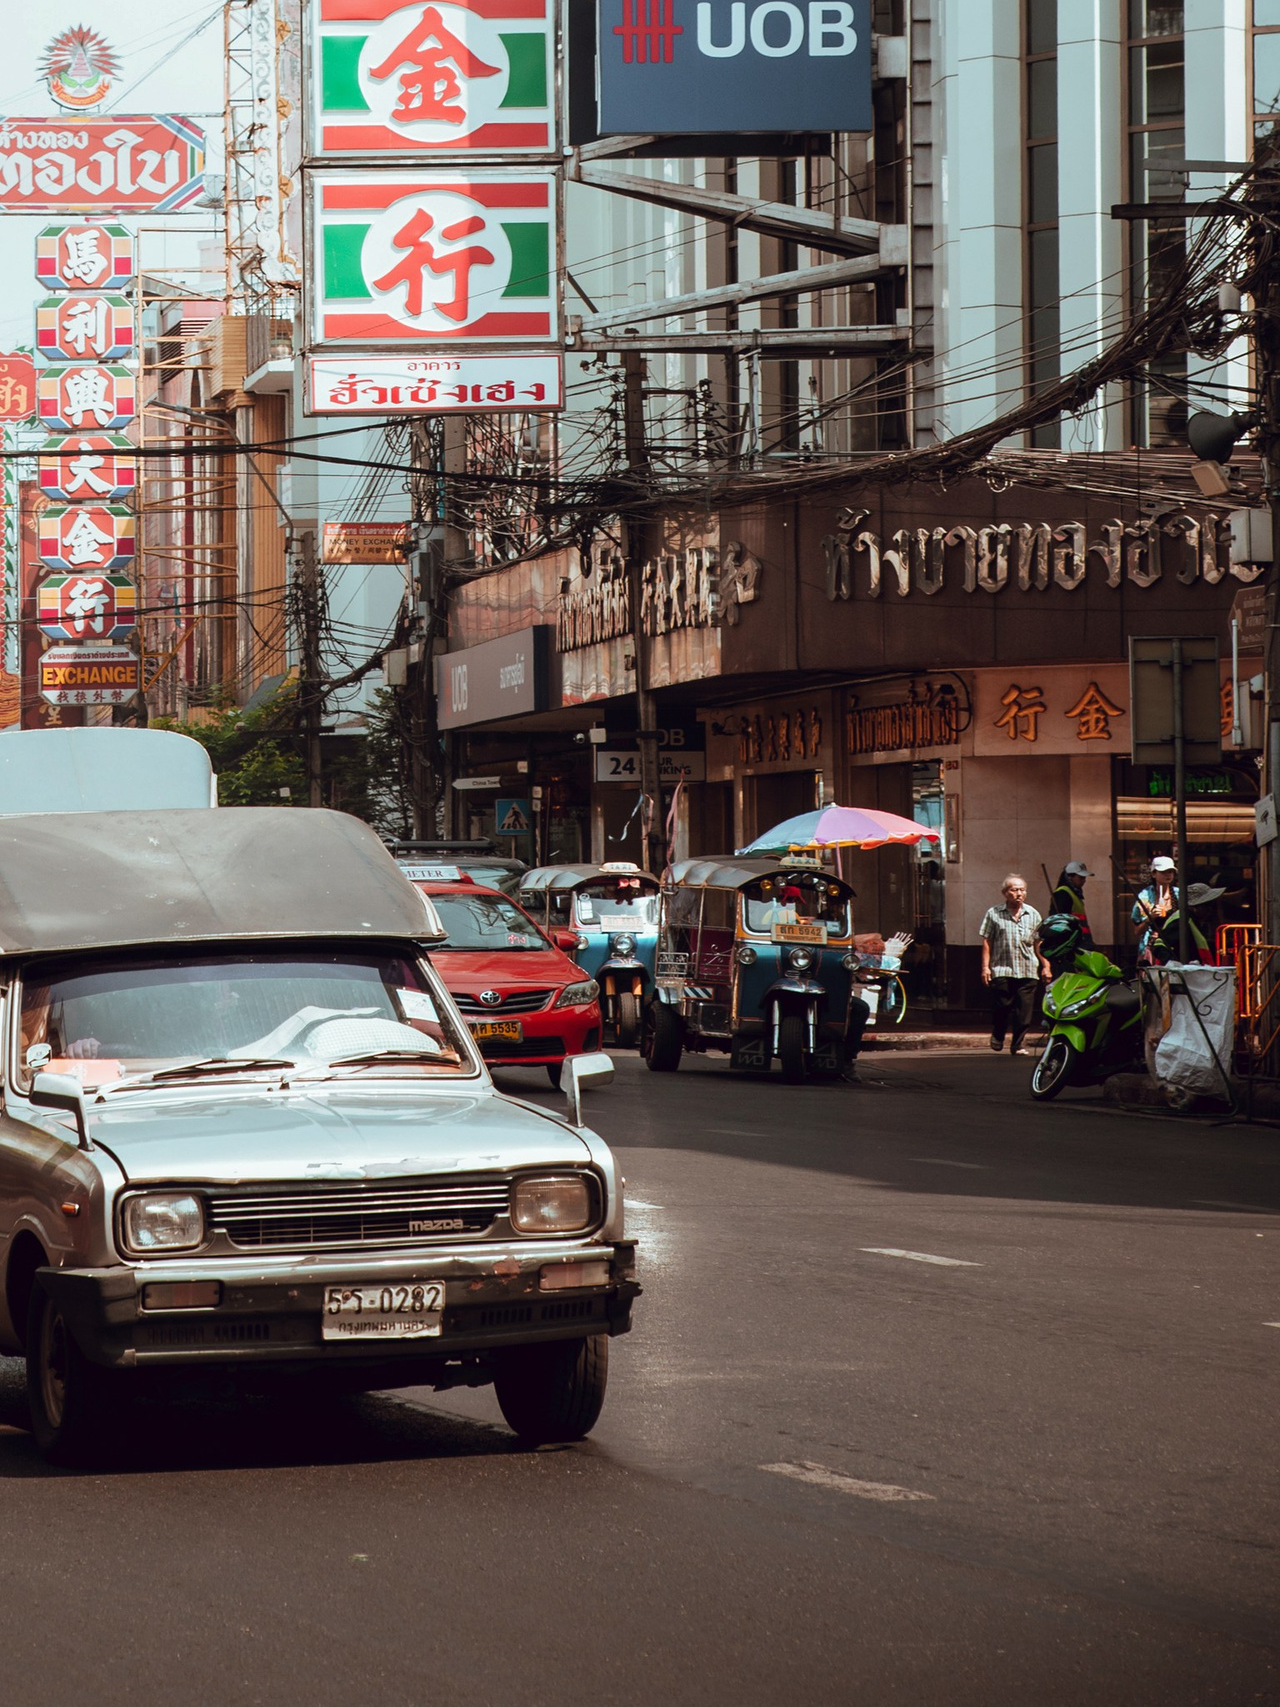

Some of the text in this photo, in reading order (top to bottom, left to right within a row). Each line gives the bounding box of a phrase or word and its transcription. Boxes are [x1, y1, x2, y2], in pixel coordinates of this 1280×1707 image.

[696, 1, 859, 58] UOB
[407, 362, 462, 372] อาคาร
[328, 373, 548, 407] ฮั่วเซ่งเฮง
[363, 538, 403, 546] EXCHAN
[42, 665, 137, 686] EXCHANGE
[451, 664, 468, 713] UOB
[608, 756, 637, 776] 24
[472, 779, 487, 787] China
[789, 856, 818, 866] TAXI
[798, 926, 822, 937] 5942
[490, 1022, 519, 1035] 5535
